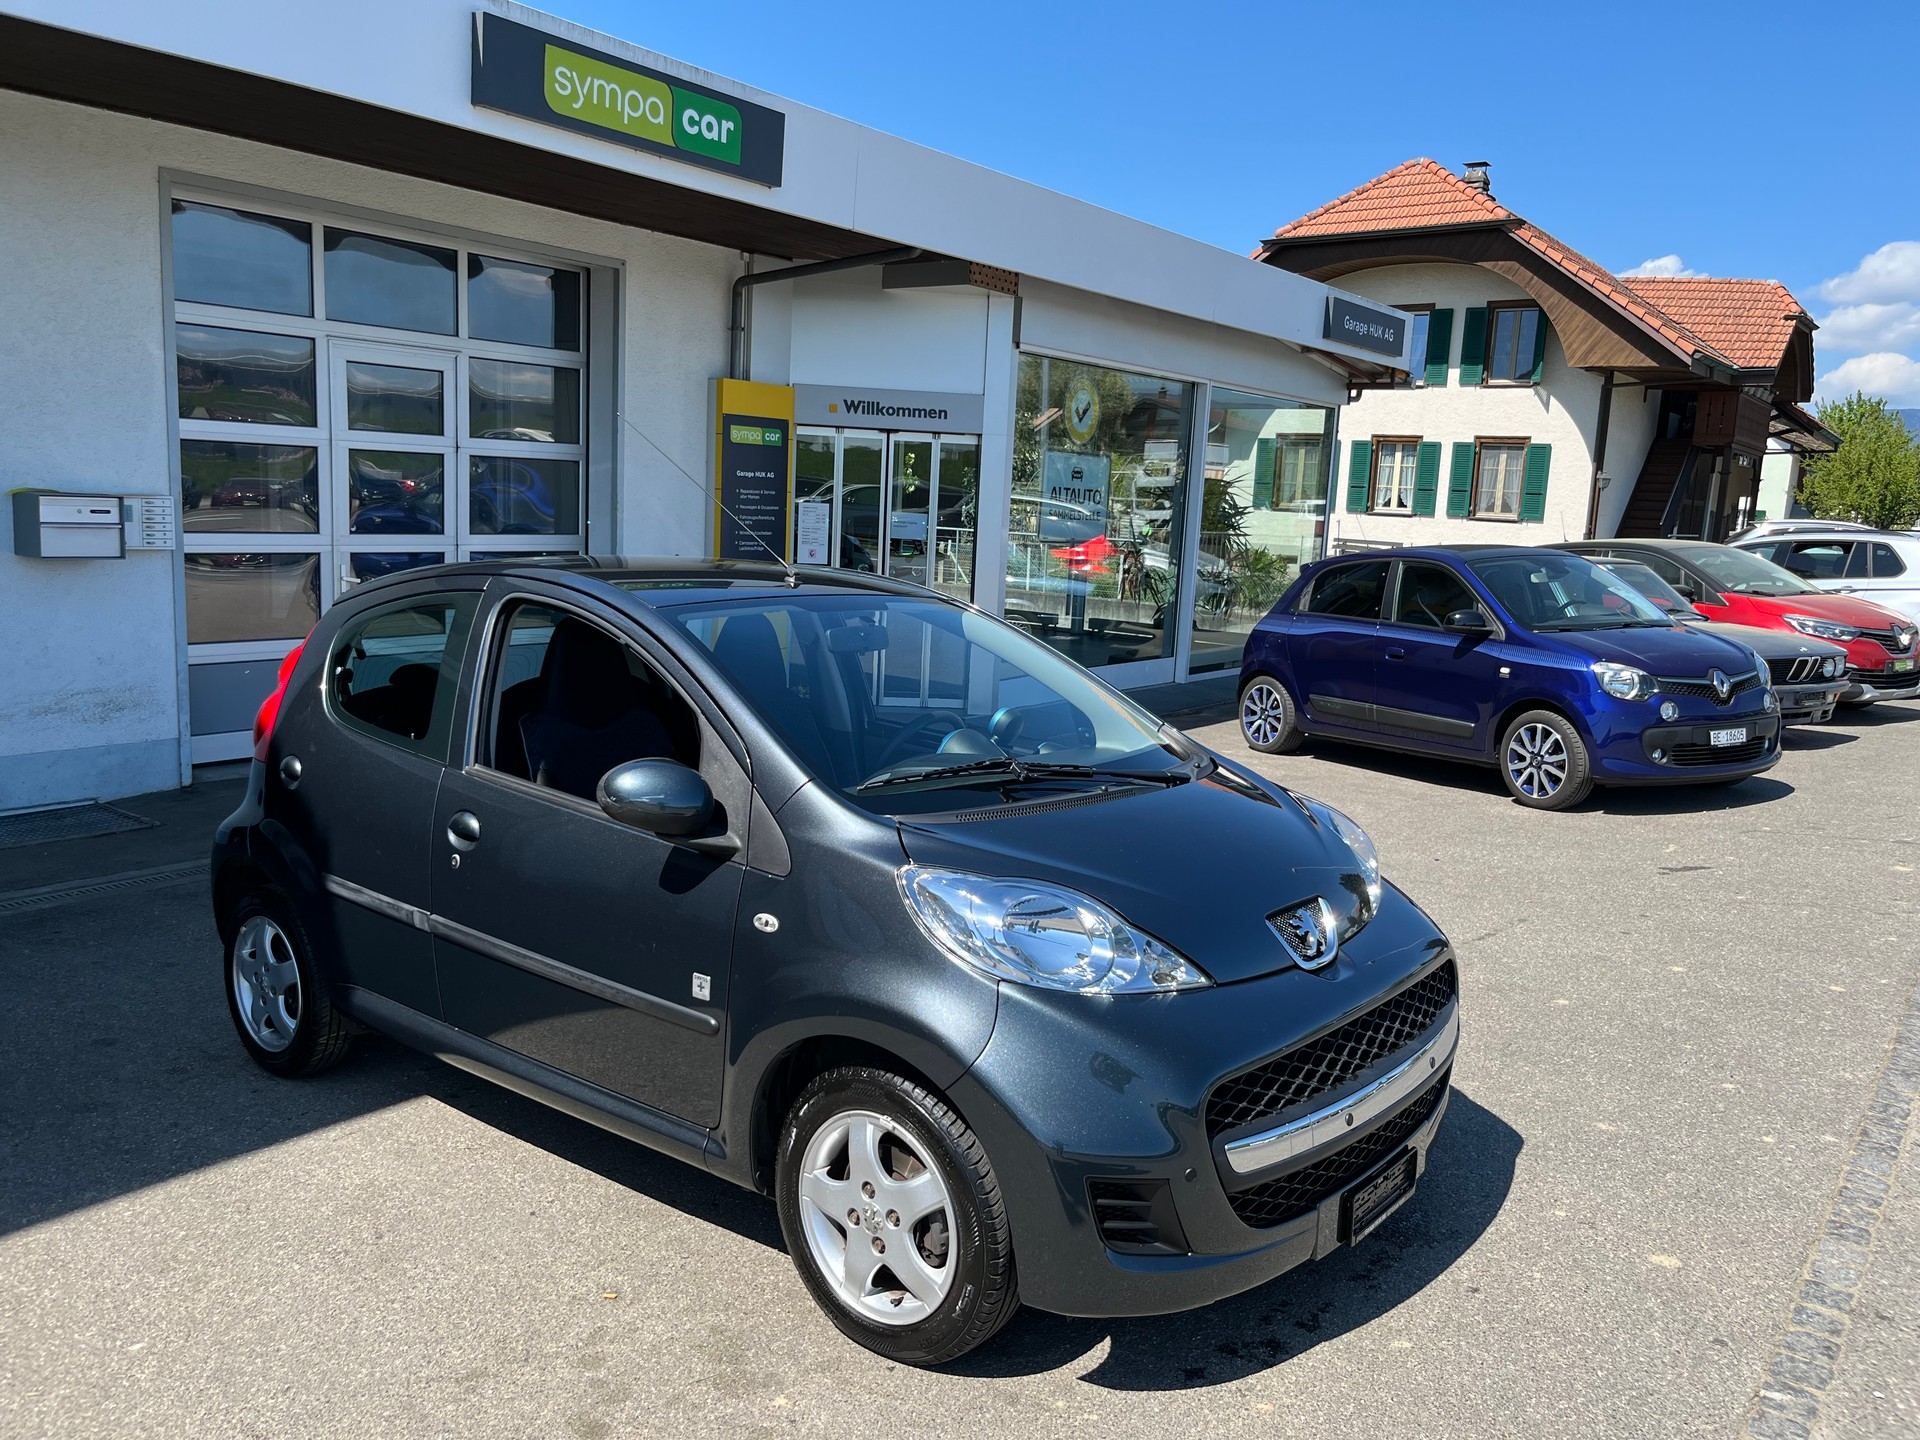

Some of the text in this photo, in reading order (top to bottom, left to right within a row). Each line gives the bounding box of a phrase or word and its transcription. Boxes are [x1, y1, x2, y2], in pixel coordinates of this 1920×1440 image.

[554, 66, 734, 144] sympa car
[1344, 315, 1394, 341] Garage HUK AG
[843, 399, 948, 420] Willkommen
[732, 430, 780, 442] sympa car
[1050, 486, 1102, 505] ALTAUTO
[1048, 508, 1101, 521] SAMMELSTELLE
[1713, 730, 1744, 743] BE 18605
